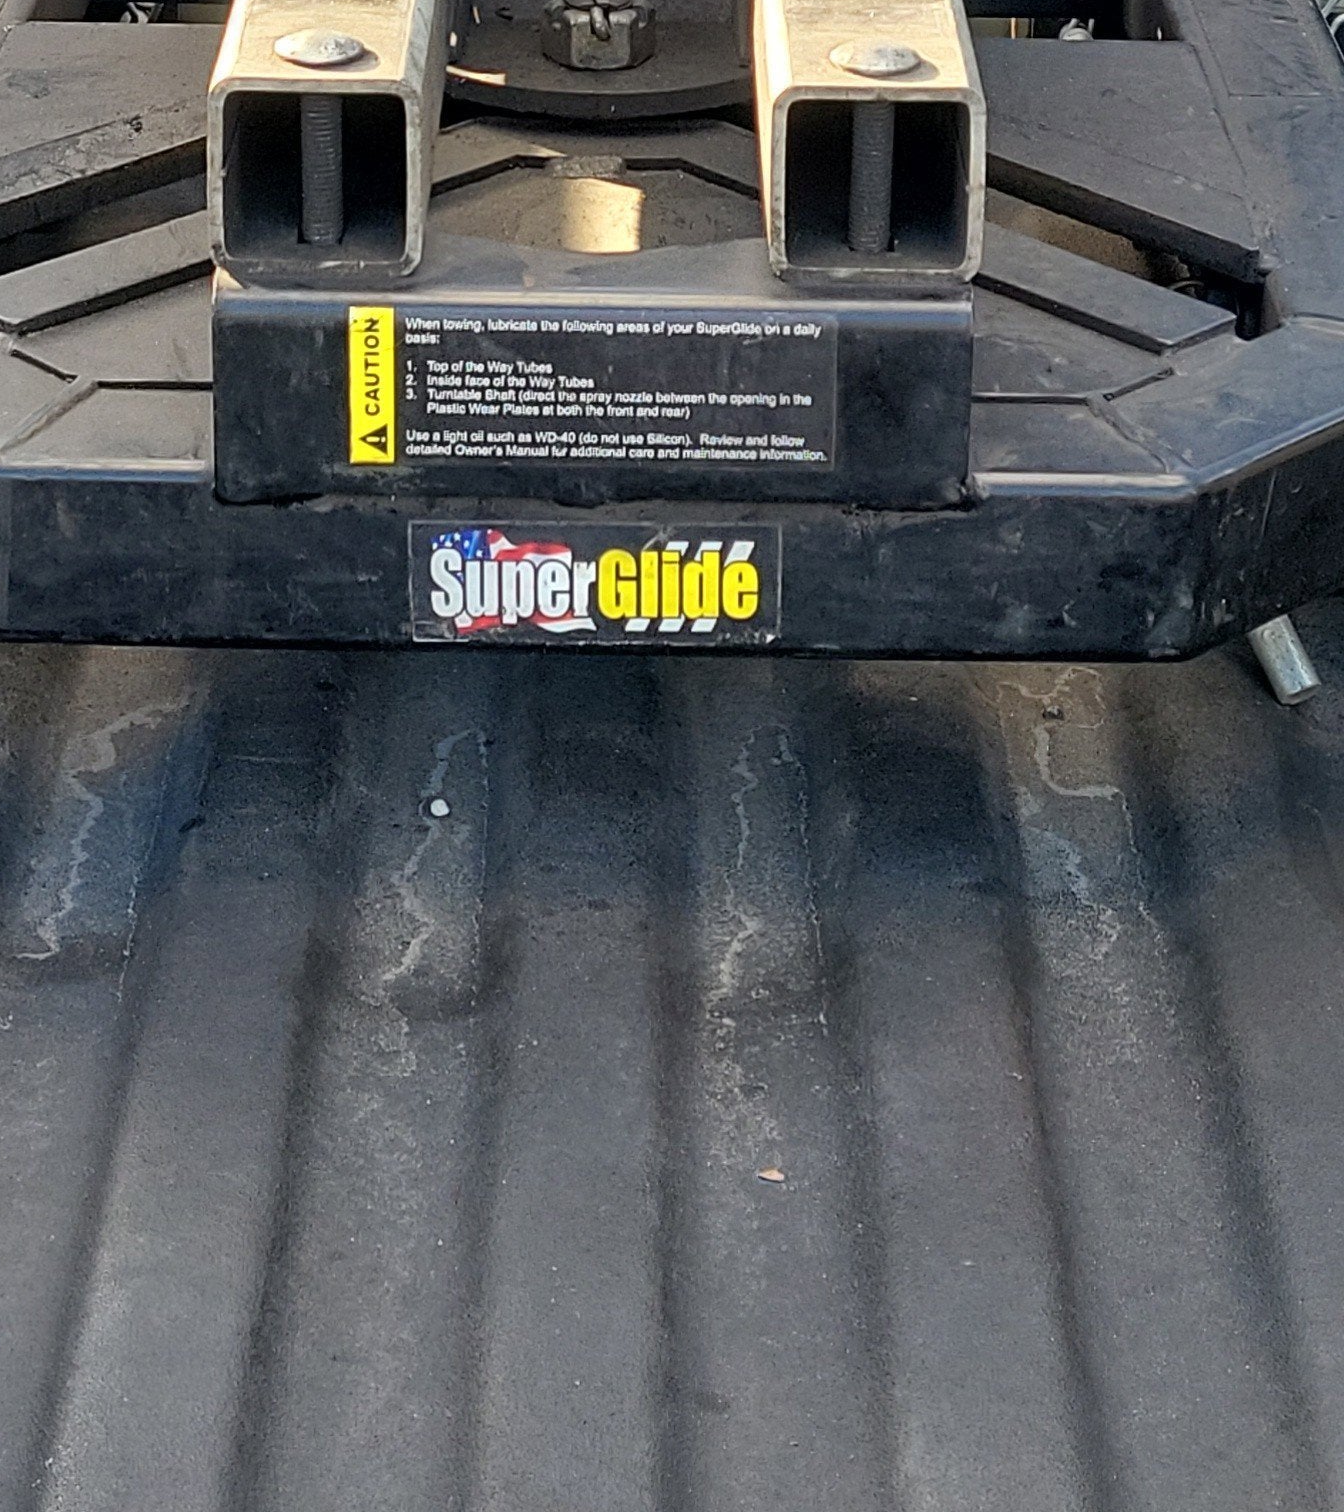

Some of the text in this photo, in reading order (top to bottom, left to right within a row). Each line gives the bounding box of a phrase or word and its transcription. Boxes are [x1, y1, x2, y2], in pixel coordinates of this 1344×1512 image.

[405, 318, 821, 339] When towing, lubricate the following areas of your SuperGlide on a daily
[405, 333, 440, 344] basis:
[364, 318, 380, 416] CAUTION
[406, 360, 553, 375] 1. Top of the Way Tubes
[405, 374, 595, 389] 2. Inside face of the Way Tubes
[406, 388, 812, 407] 3. Turntable Shaft (direct the spray nozzle between the opening in the
[427, 402, 690, 419] Plastic Wear Plates at both the front and rear)
[406, 429, 429, 441] Use
[433, 432, 440, 441] a
[444, 430, 467, 443] light
[470, 430, 484, 442] oil
[487, 432, 514, 442] such
[518, 433, 532, 442] as
[535, 432, 575, 443] WD-40
[578, 432, 598, 444] (do
[601, 433, 619, 443] not
[623, 435, 644, 444] use
[700, 434, 742, 446] Review
[746, 435, 767, 446] and
[771, 435, 804, 447] follow
[406, 444, 451, 455] detailed
[455, 444, 503, 456] Owner's
[506, 445, 549, 456] Manual
[570, 446, 626, 457] additional
[629, 449, 654, 458] care
[657, 448, 678, 458] and
[682, 449, 756, 459] maintenance
[760, 449, 827, 461] information.
[430, 549, 758, 624] SuperGlide
